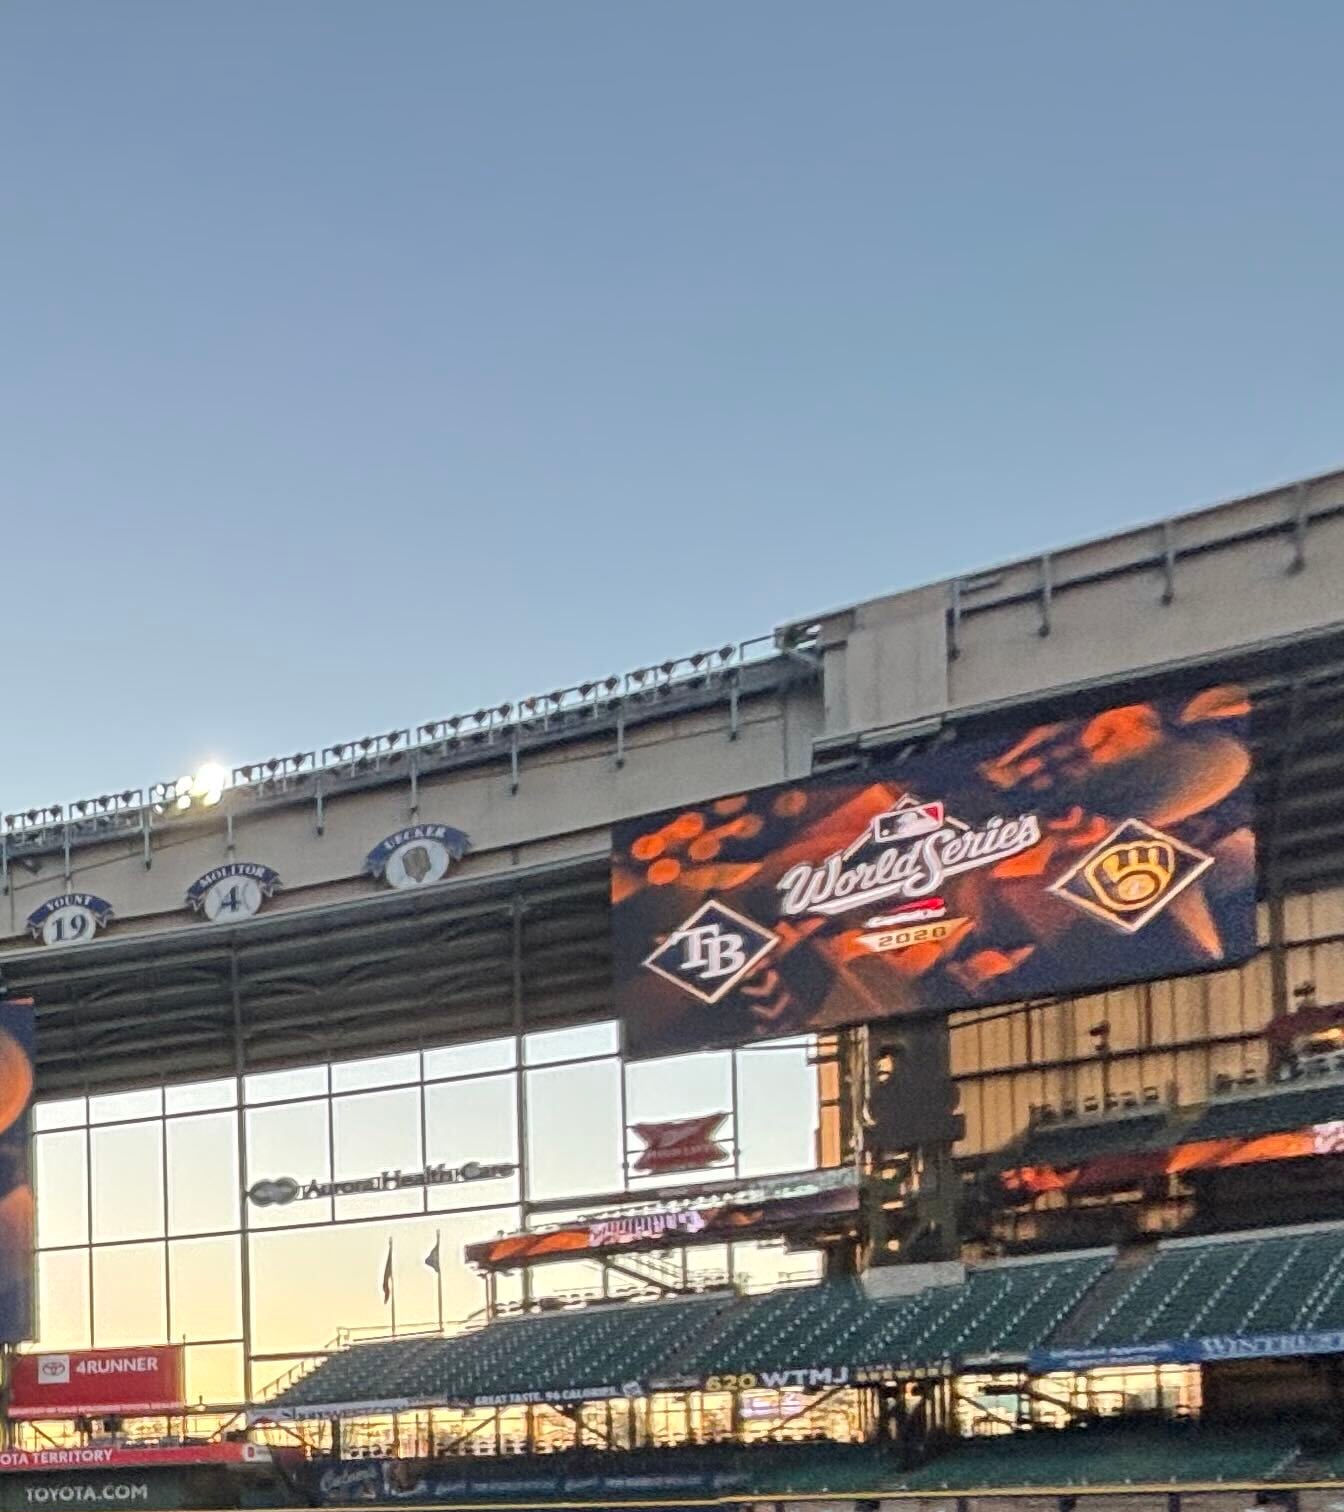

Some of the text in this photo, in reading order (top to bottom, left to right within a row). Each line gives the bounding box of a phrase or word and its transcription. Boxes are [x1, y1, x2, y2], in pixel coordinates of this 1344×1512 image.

[199, 864, 266, 888] MOLITOR
[777, 815, 1042, 915] World Series
[46, 895, 91, 911] YOUNT
[221, 888, 240, 912] 4
[52, 914, 87, 942] 19
[671, 923, 746, 980] TB
[304, 1179, 374, 1200] Aurora
[75, 1356, 159, 1374] 4RUNNER
[705, 1374, 758, 1391] 620
[760, 1366, 849, 1388] WTMJ
[32, 1449, 112, 1465] TERRITORY
[26, 1484, 148, 1502] TOYOTA.COM
